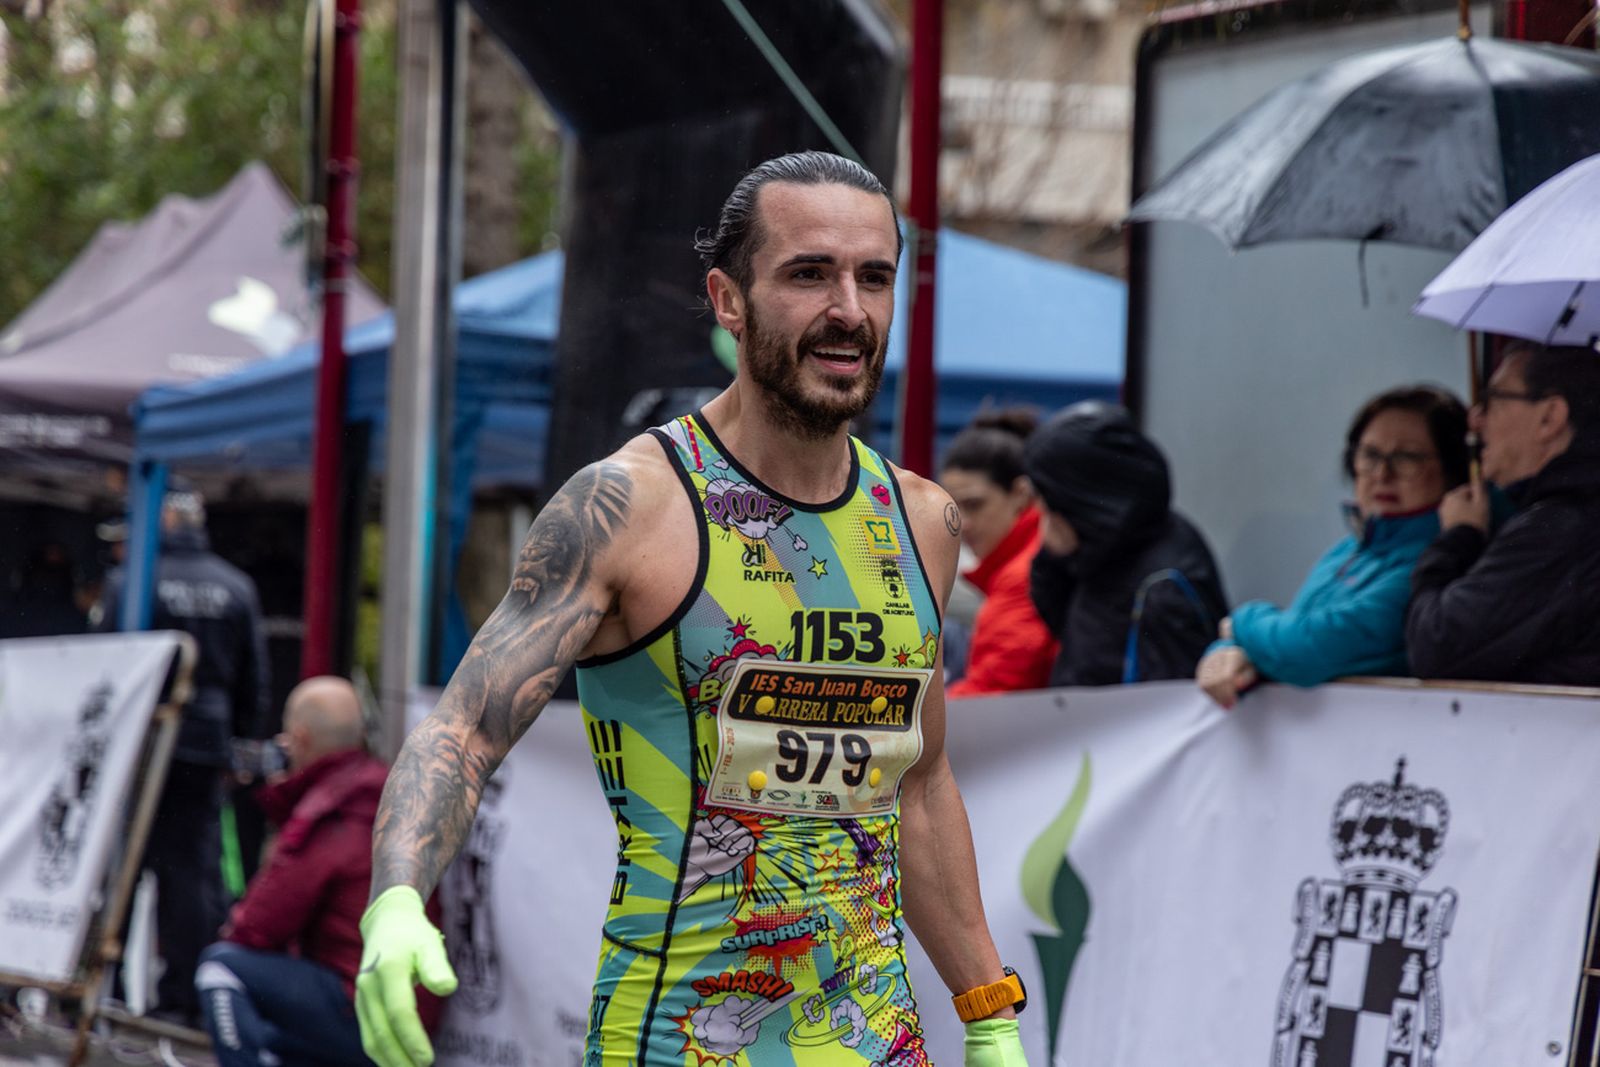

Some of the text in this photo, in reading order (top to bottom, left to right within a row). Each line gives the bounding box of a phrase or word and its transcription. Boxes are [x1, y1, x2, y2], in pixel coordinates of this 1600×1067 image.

[703, 490, 793, 530] POOF!
[744, 570, 795, 583] RAFITA
[790, 610, 886, 663] 1153
[750, 673, 908, 699] IES San Juan Bosco
[738, 693, 752, 714] V
[754, 695, 829, 722] ARRERA
[775, 730, 872, 787] 979
[691, 969, 795, 1002] SMASH!
